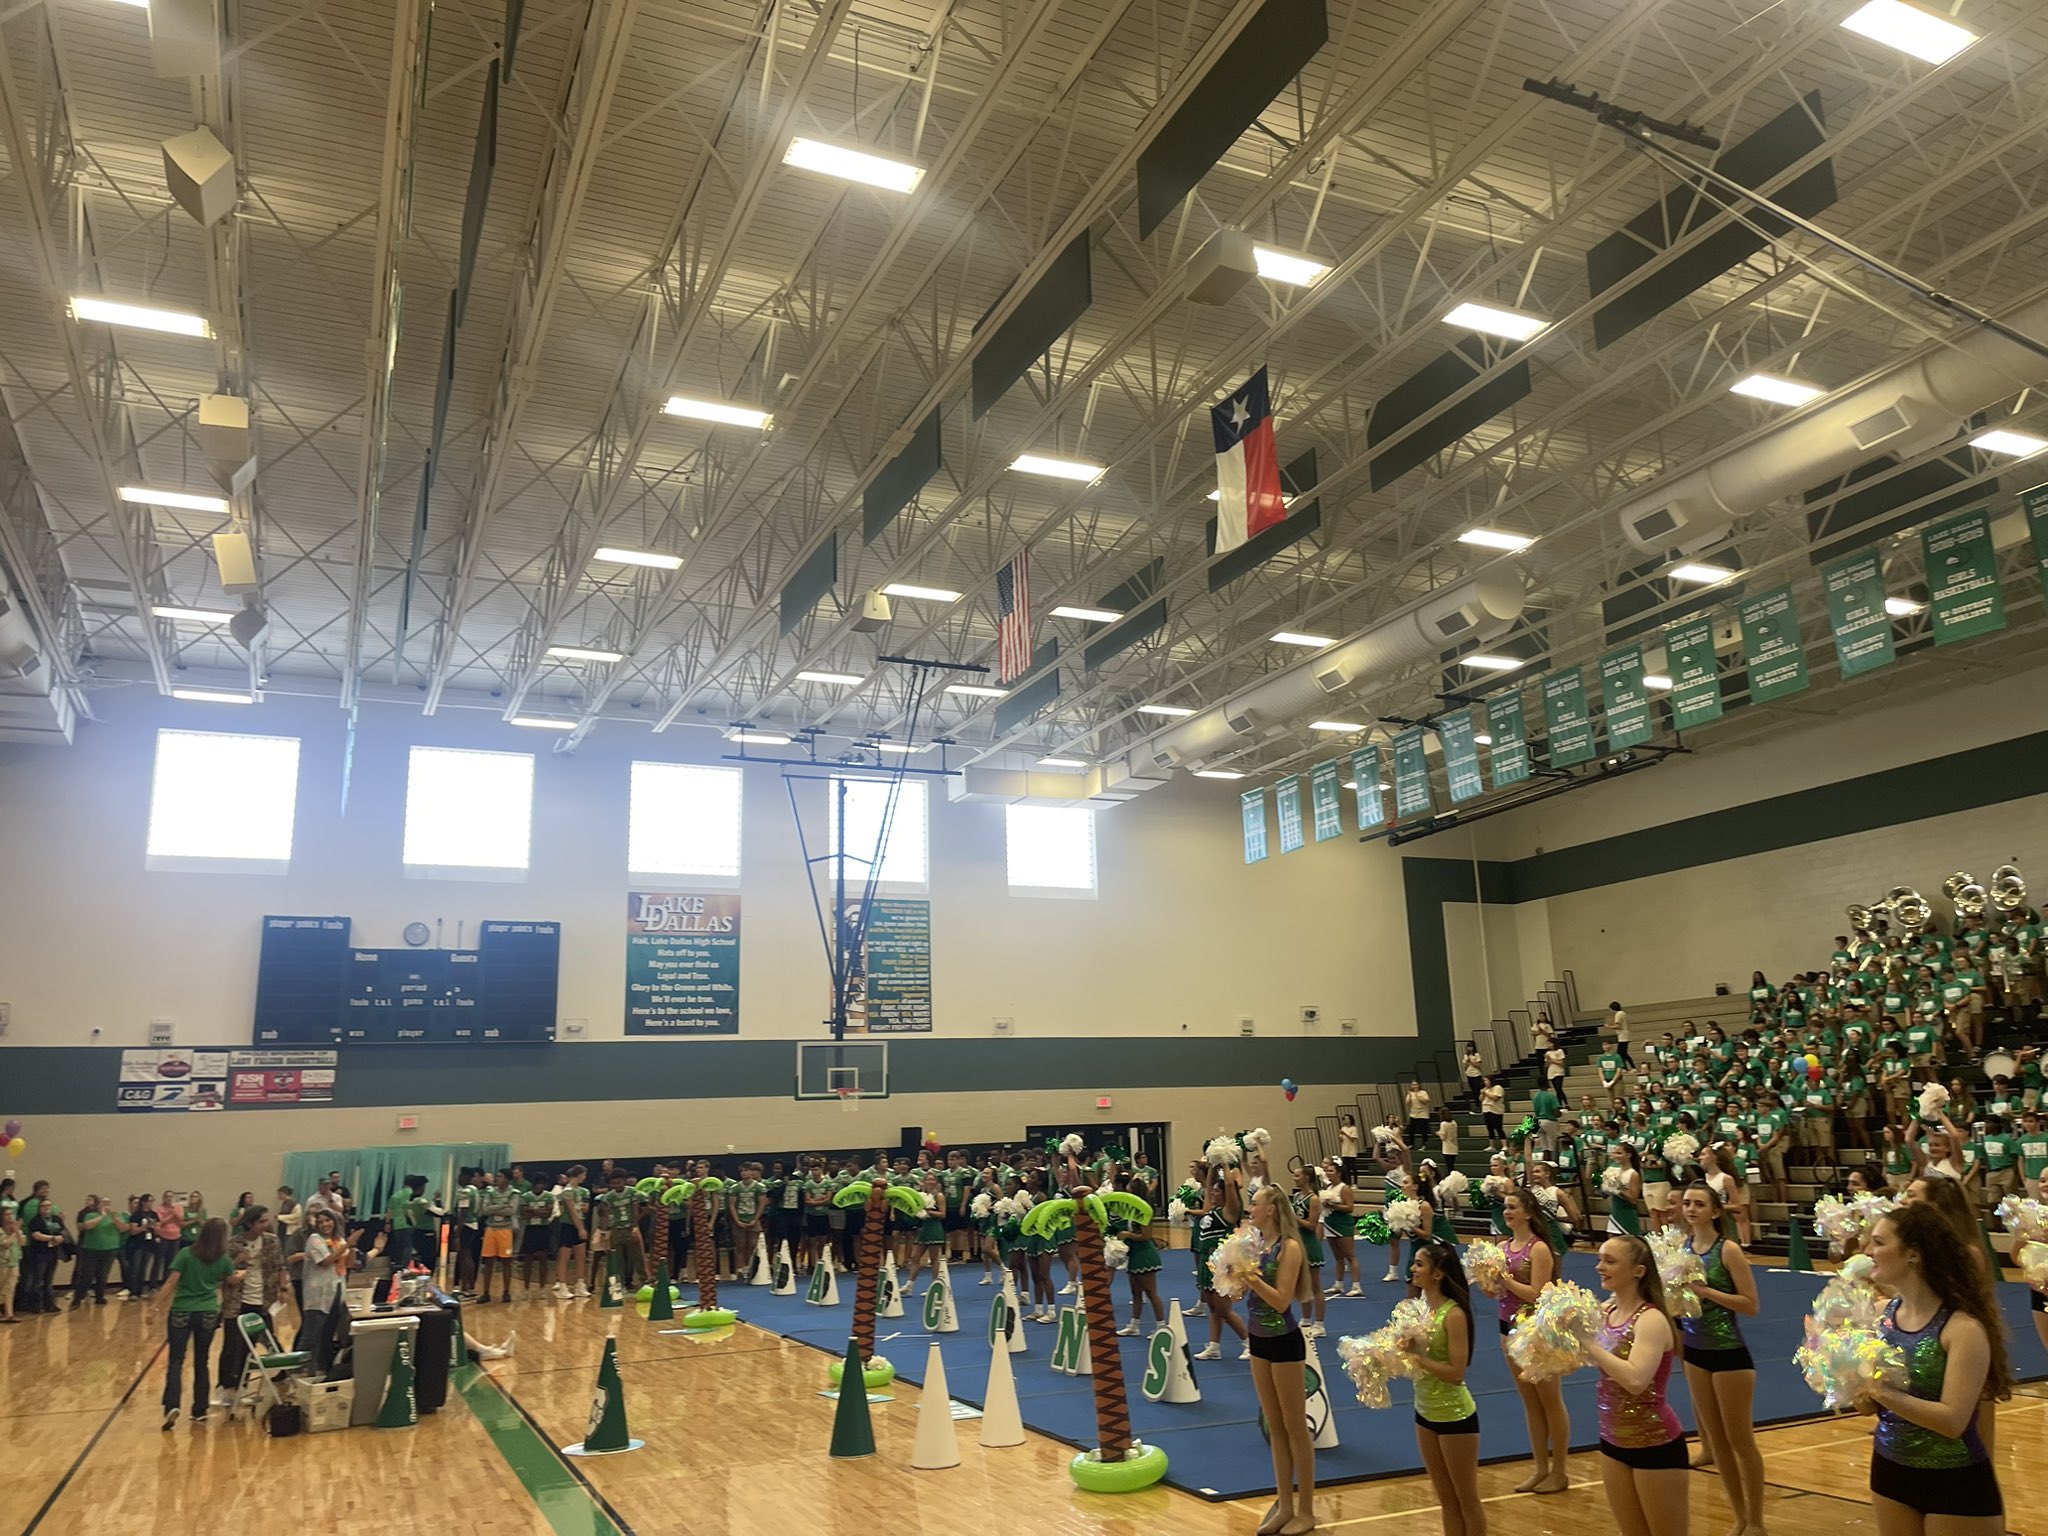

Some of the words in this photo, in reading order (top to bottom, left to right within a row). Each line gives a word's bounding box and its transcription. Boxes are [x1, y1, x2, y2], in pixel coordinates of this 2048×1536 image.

[1928, 530, 1950, 542] LAKE
[1952, 518, 1983, 534] DALLAS
[1828, 570, 1846, 580] LAKE
[1847, 559, 1875, 573] DALLAS
[1947, 568, 1976, 584] GIRLS
[1933, 575, 1996, 600] BASKETBALL
[1742, 603, 1760, 614] LAKE
[1761, 593, 1787, 606] DALLAS
[1845, 606, 1870, 620] GIRLS
[1836, 612, 1886, 636] VOLLEYBALL
[1944, 606, 1992, 625] FINALISTS
[1749, 642, 1799, 666] BASKETBALL
[1760, 636, 1784, 651] GIRLS
[635, 894, 705, 922] LAKE
[643, 904, 734, 933] DALLAS
[124, 1090, 151, 1099] C&G
[1051, 1308, 1088, 1374] N
[1143, 1329, 1174, 1400] S
